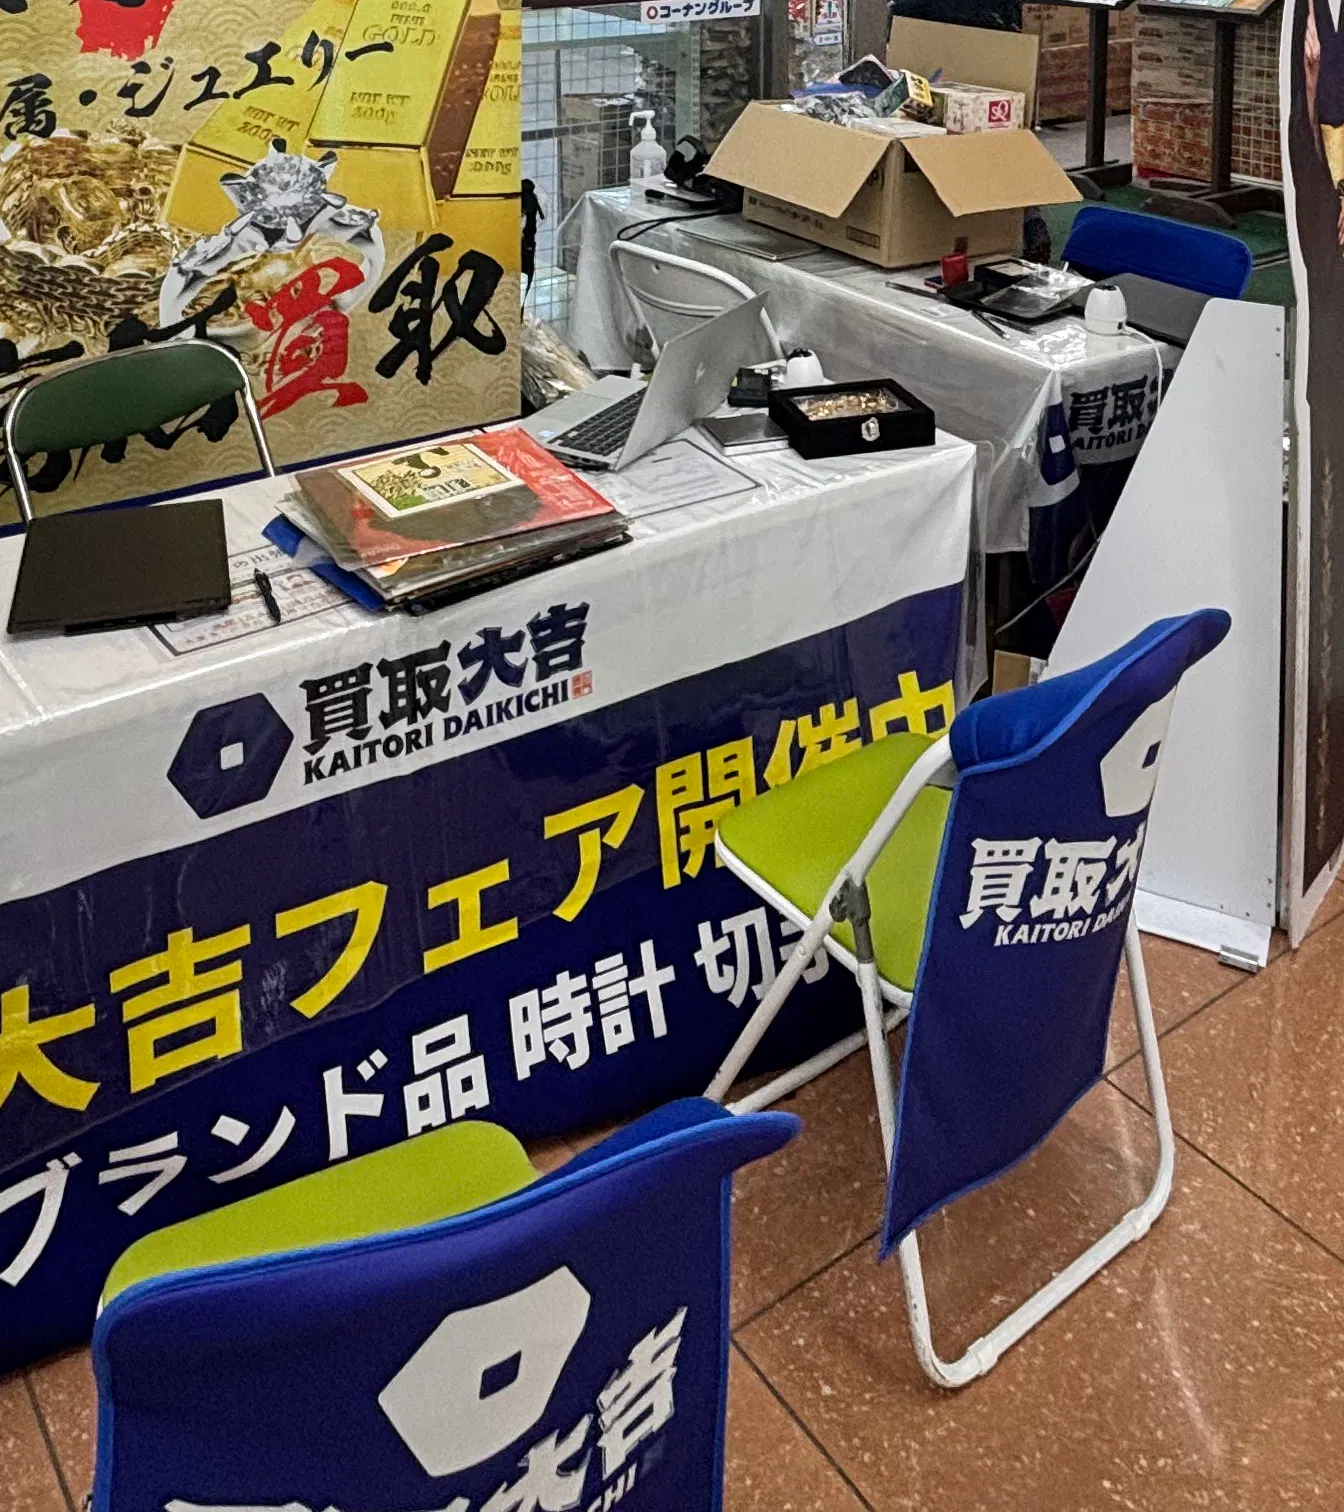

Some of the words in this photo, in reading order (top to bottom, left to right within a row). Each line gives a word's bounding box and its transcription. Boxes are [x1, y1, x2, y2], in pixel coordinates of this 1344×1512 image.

[300, 601, 591, 755] 買取大吉
[302, 726, 435, 786] KAITORI
[442, 679, 570, 743] DAIKICHI
[993, 916, 1090, 947] KAITORI
[508, 953, 677, 1083] 時計
